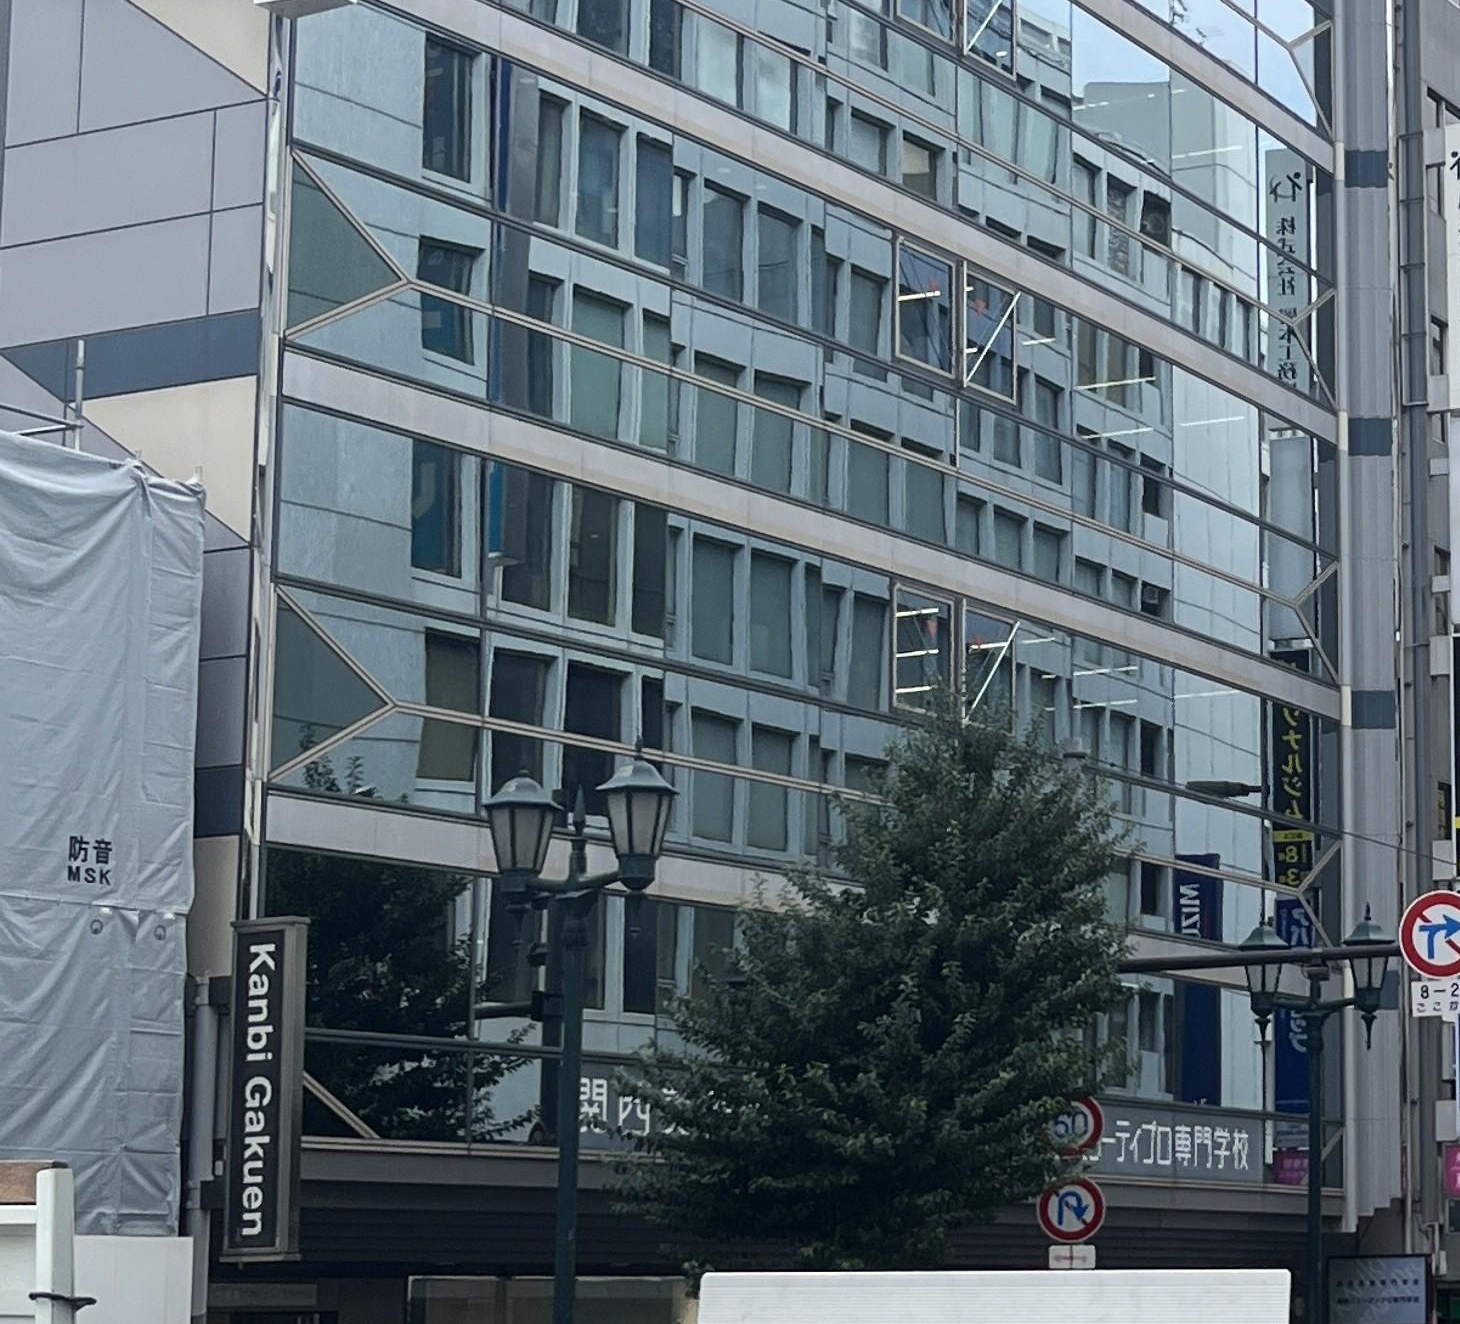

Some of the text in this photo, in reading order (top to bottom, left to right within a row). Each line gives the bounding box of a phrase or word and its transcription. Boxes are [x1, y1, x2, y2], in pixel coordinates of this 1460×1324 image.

[67, 835, 113, 865] 防音
[67, 865, 112, 886] MSK
[241, 943, 277, 1237] Kanbi Gakuen
